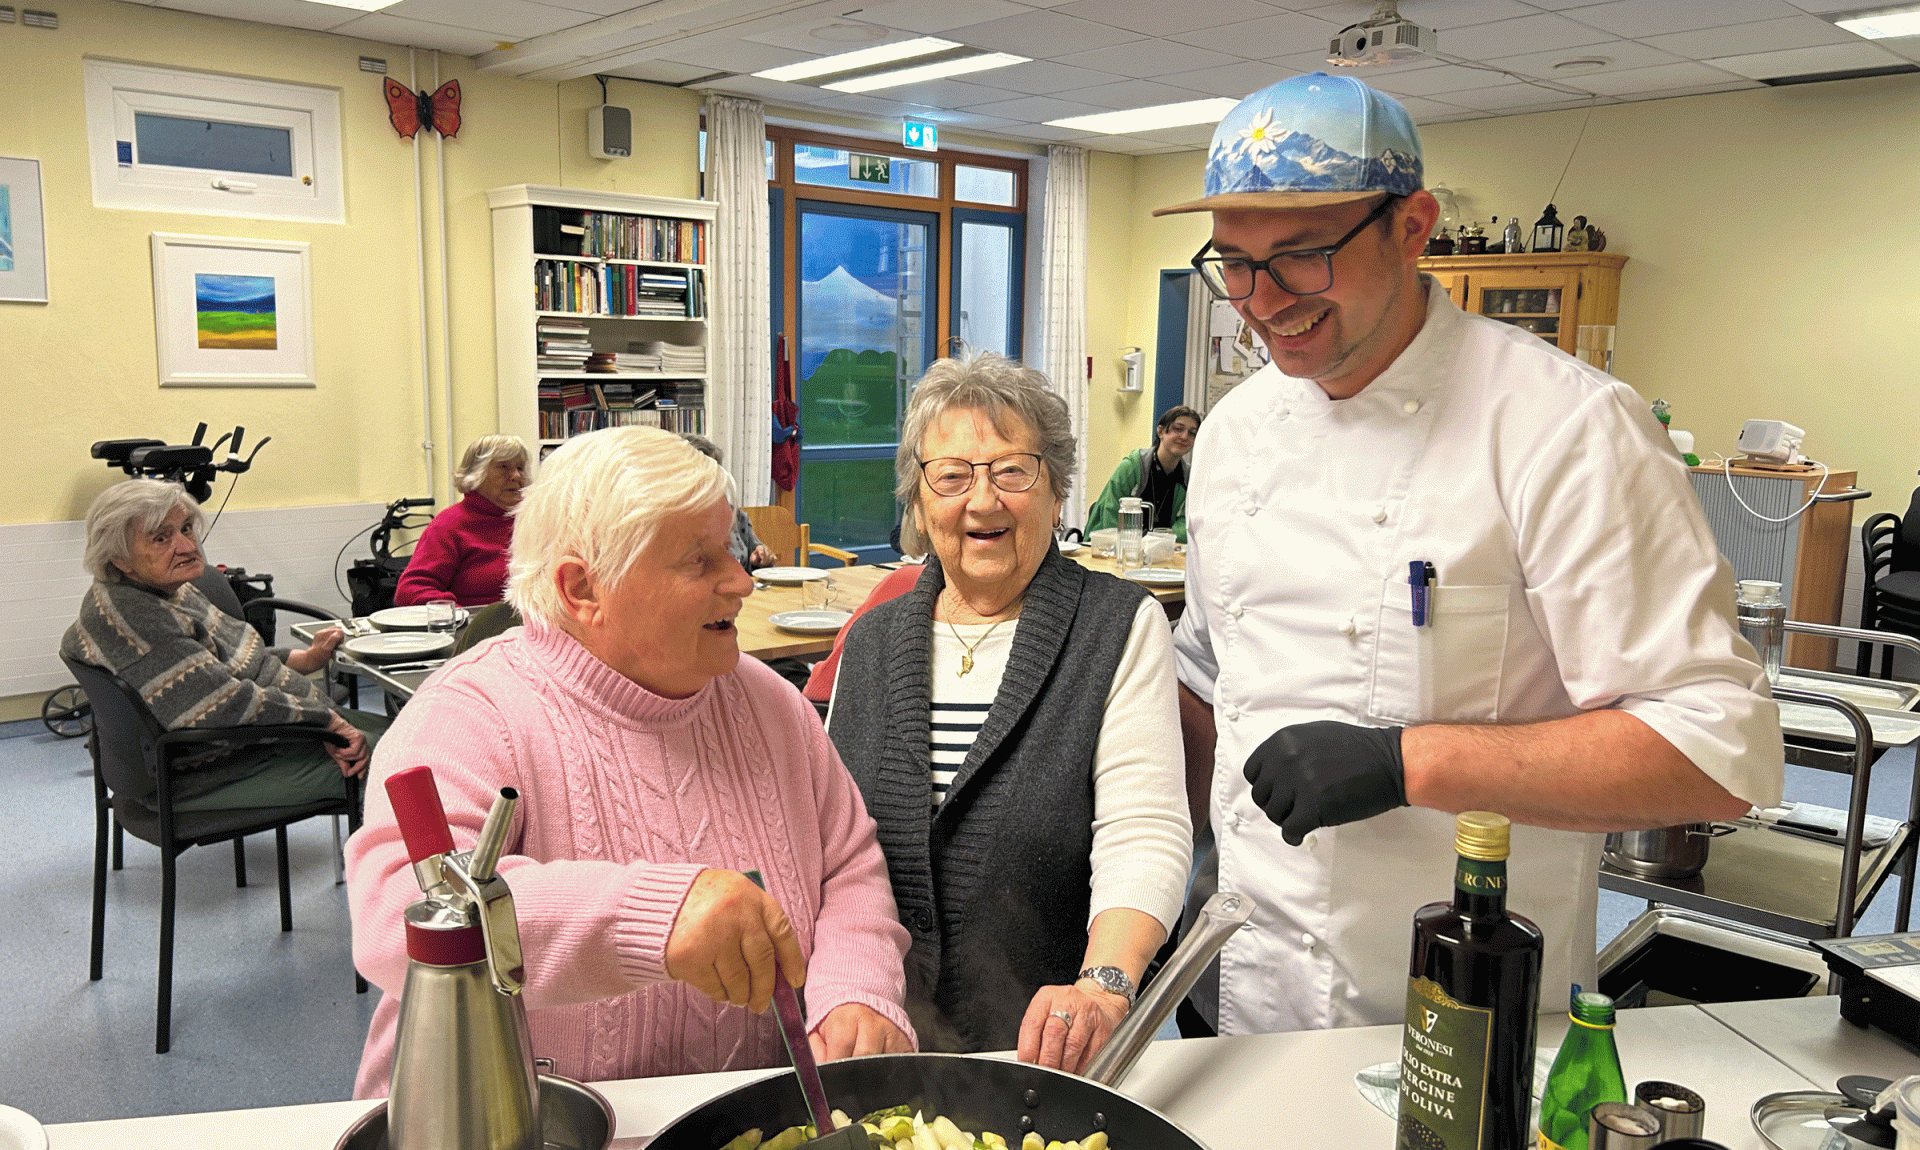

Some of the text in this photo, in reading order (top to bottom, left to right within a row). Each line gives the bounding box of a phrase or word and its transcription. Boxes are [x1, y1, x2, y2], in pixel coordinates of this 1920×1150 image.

[1407, 1023, 1454, 1057] VERONESI
[1403, 1063, 1456, 1104] VERGINE
[1420, 1062, 1463, 1089] EXTRA
[1401, 1079, 1454, 1120] DI OLIVA
